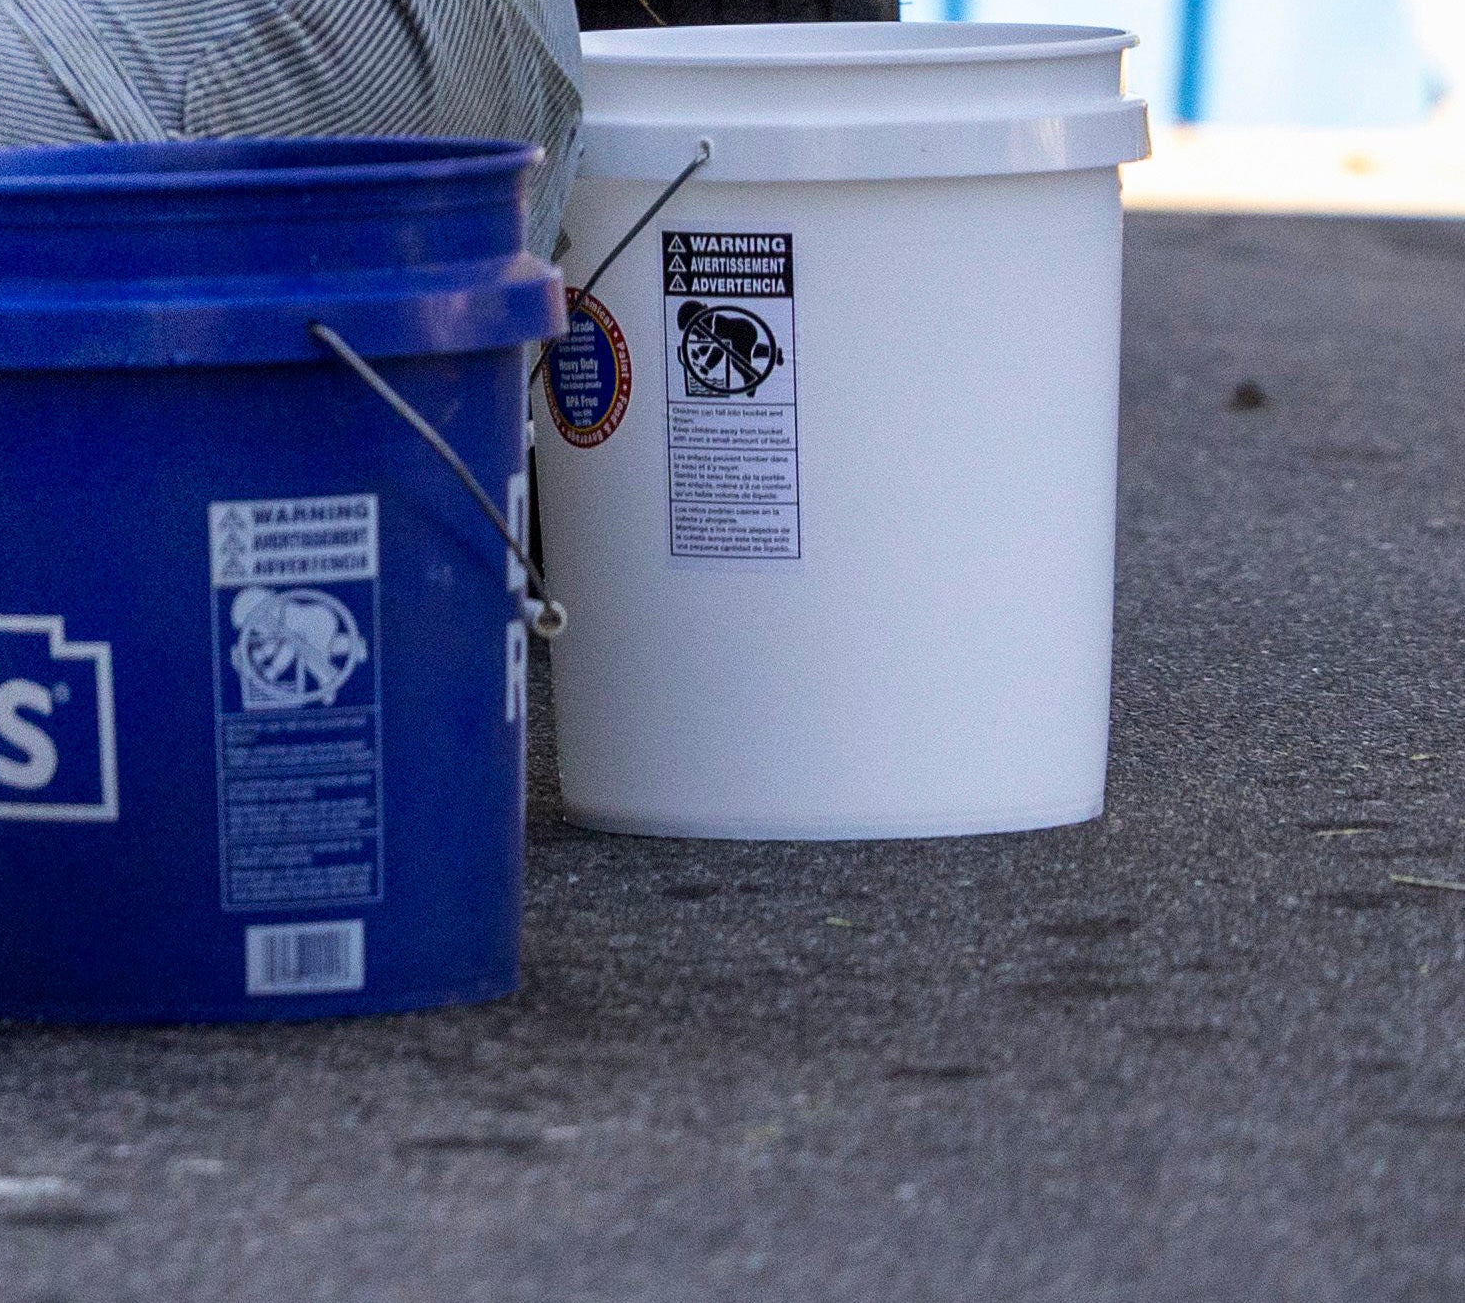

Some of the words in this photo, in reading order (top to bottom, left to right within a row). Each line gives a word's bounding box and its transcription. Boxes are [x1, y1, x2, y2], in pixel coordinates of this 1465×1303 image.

[690, 236, 786, 253] WARNING
[691, 256, 785, 274] AVERTISSEMENT
[692, 277, 785, 294] ADVERTENCIA
